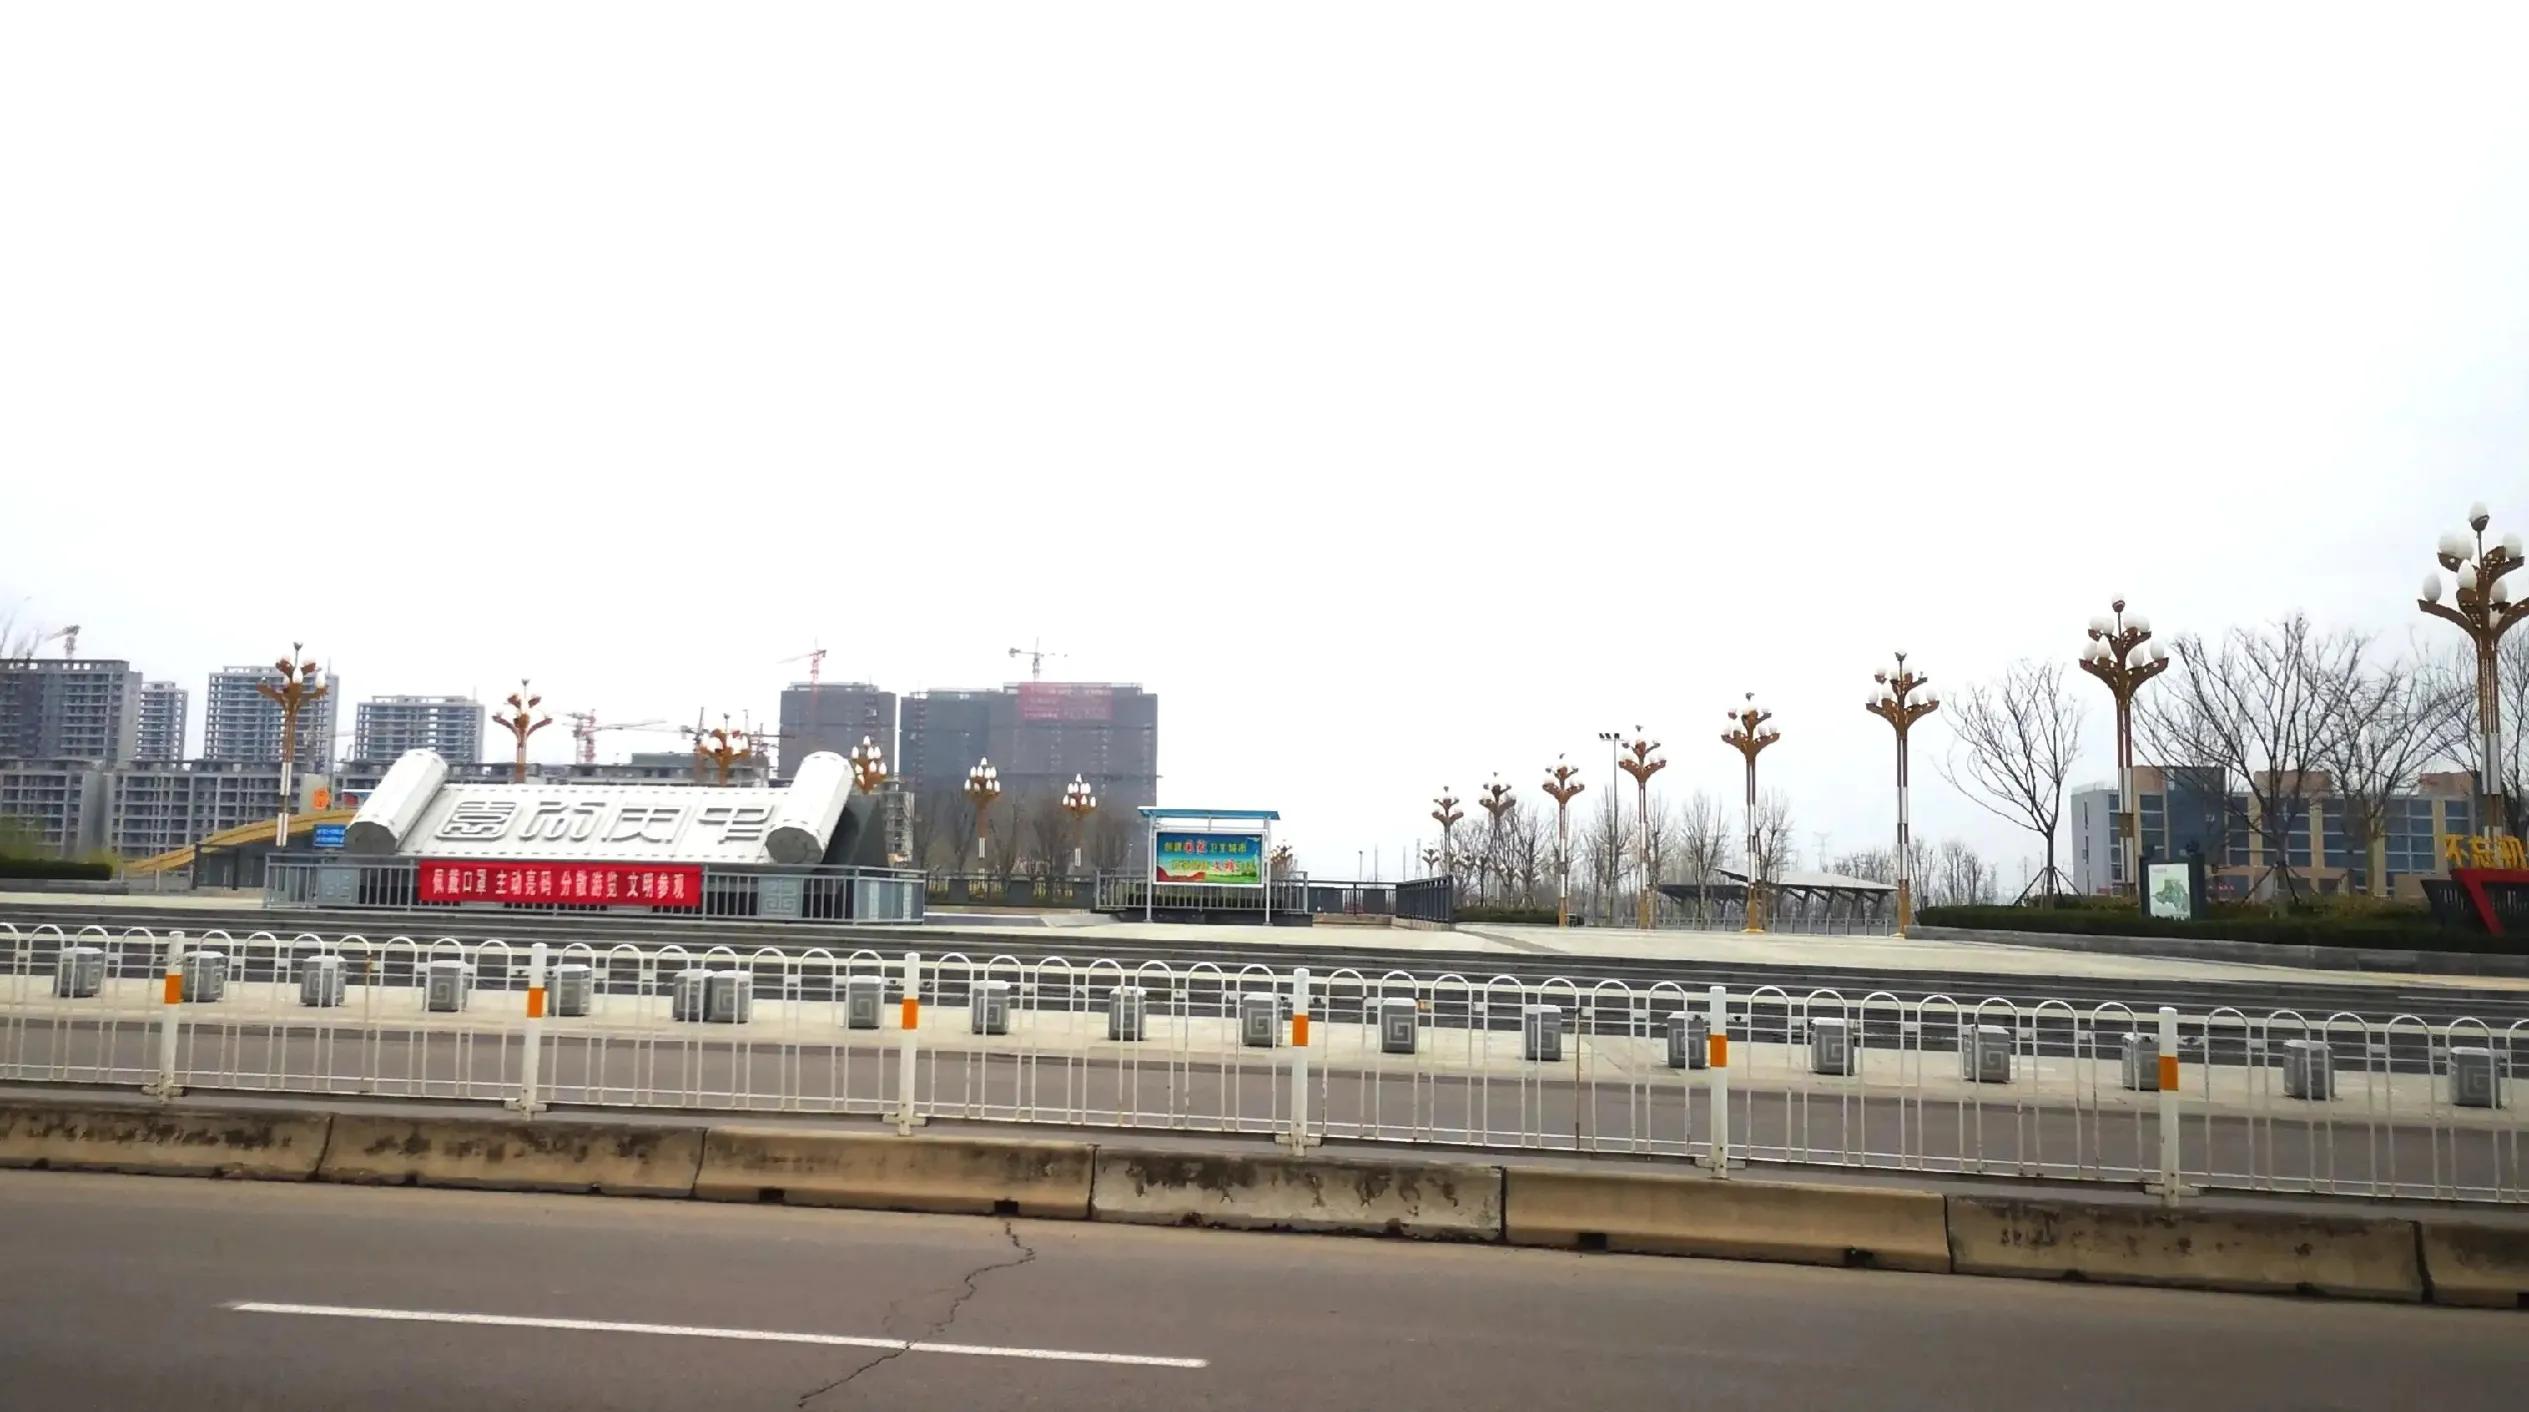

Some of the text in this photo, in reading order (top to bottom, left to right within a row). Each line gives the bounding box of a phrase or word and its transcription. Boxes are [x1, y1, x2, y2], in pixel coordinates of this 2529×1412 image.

[432, 868, 685, 899] 佩戴口罩 主动亮码 分散游览 文明参观
